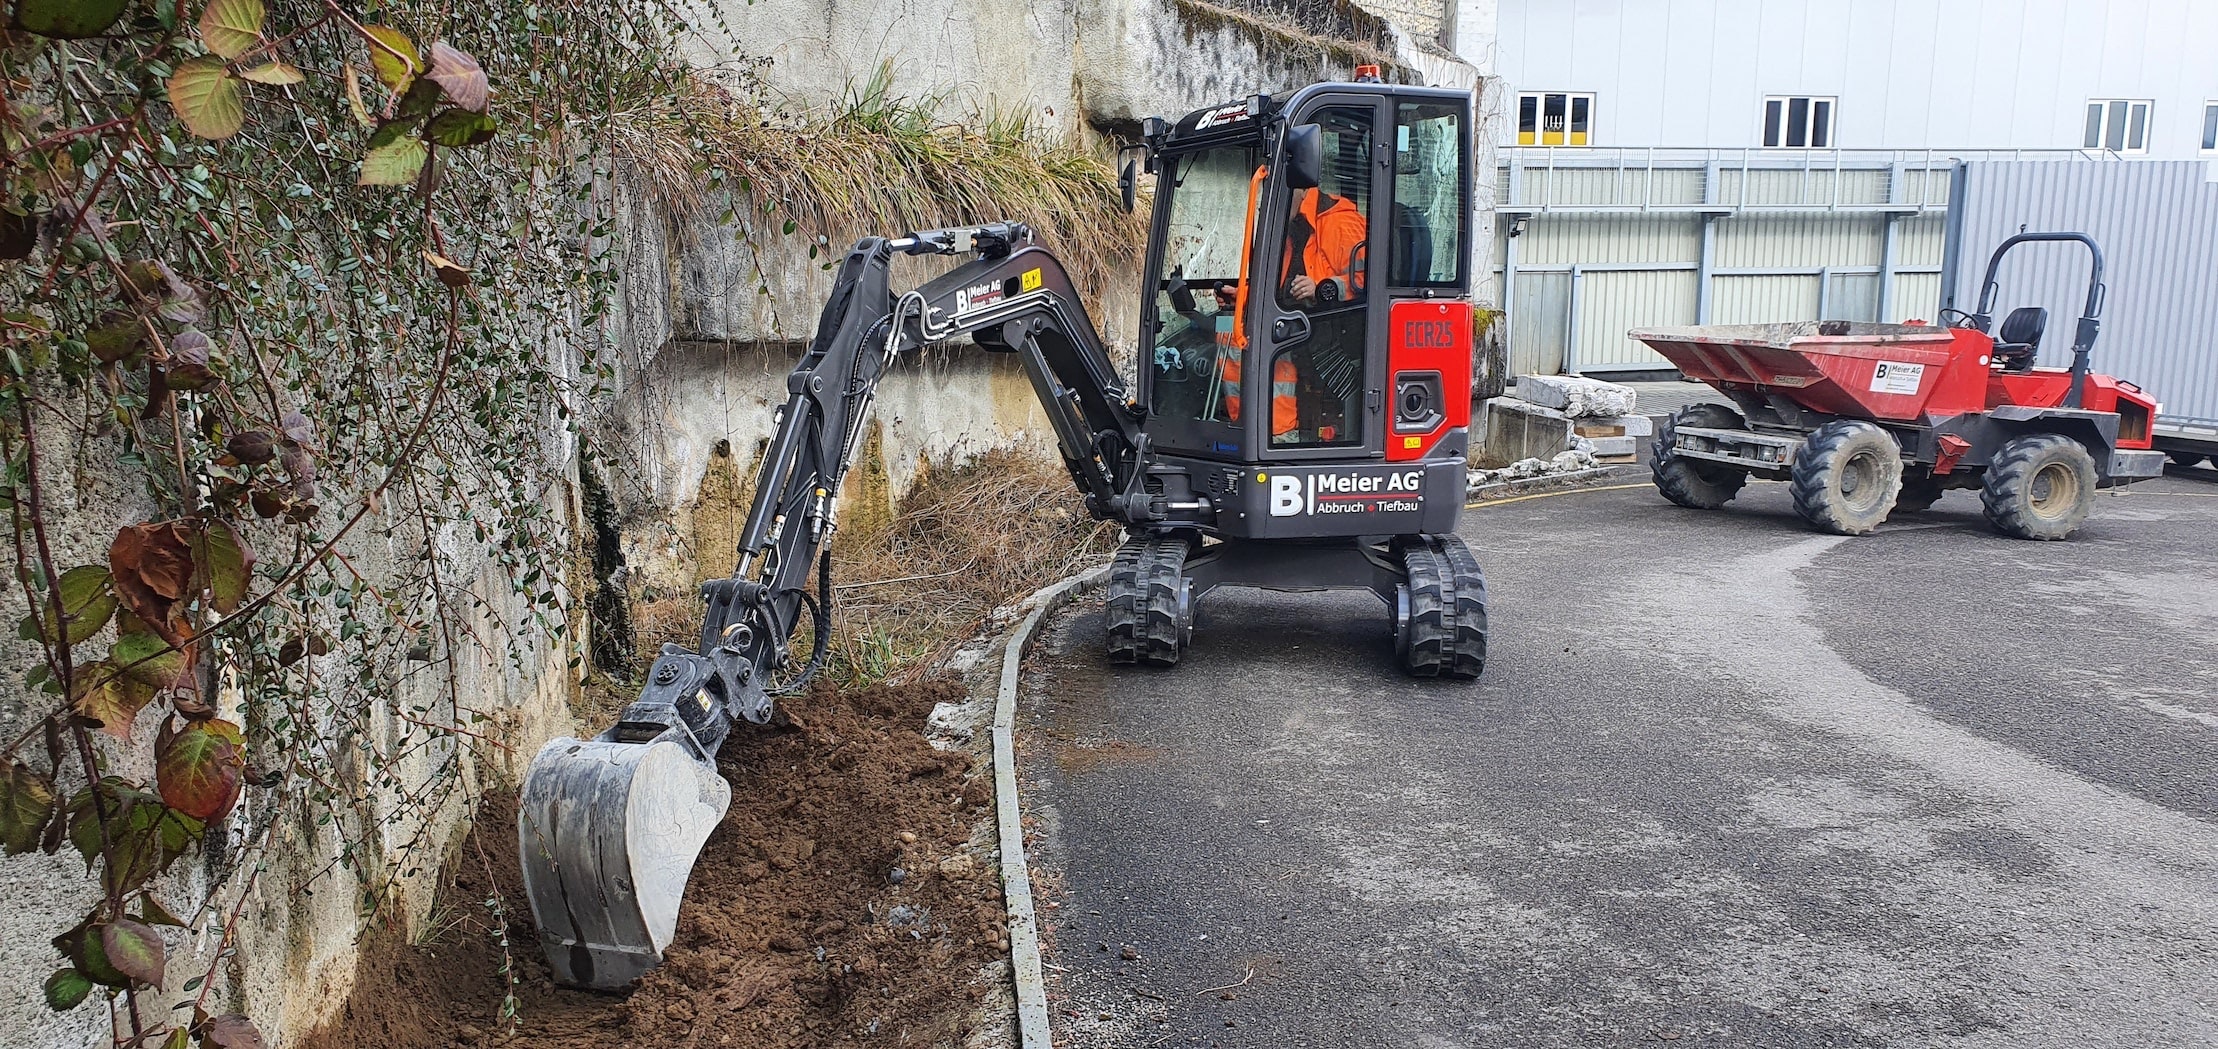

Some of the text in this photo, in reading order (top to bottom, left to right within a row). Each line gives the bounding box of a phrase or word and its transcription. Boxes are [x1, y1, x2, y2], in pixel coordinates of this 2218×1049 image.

[1195, 109, 1217, 130] B
[970, 279, 1001, 298] Meier AG
[956, 290, 968, 314] B
[1406, 322, 1453, 347] ECR25
[1876, 364, 1887, 378] B
[1891, 365, 1910, 373] Meier
[1318, 472, 1419, 492] Meier AG
[1270, 476, 1303, 516] B
[1317, 501, 1418, 513] Abbruch Tiefbau
